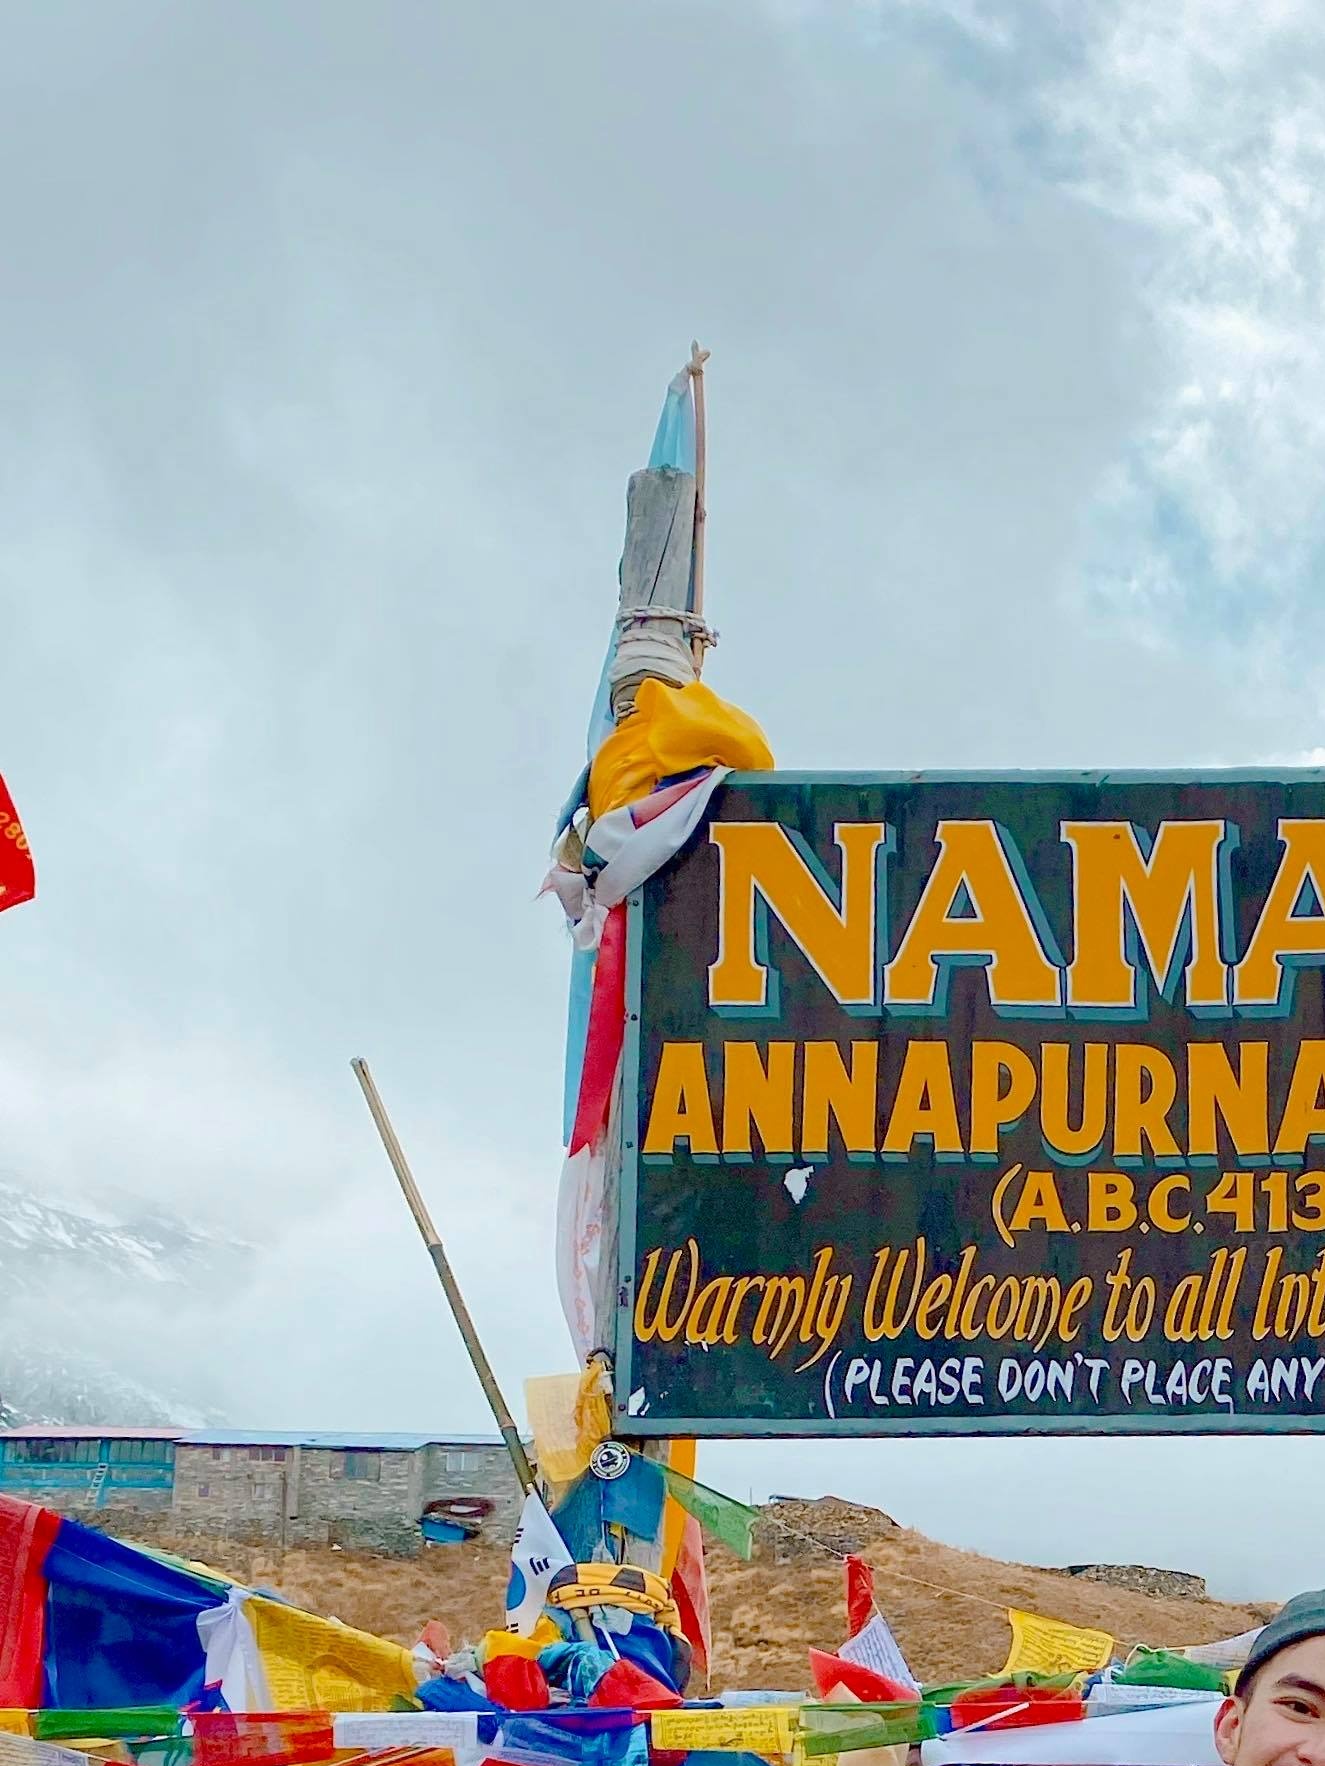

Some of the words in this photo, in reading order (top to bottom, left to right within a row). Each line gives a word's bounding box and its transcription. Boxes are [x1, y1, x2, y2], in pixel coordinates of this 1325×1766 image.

[634, 1237, 852, 1372] Warmly
[864, 1236, 1092, 1352] Welcome
[1103, 1247, 1154, 1343] to
[1162, 1245, 1248, 1341] all
[824, 1350, 985, 1418] (PLEASE
[999, 1352, 1108, 1405] DON'T
[1121, 1355, 1235, 1405] PLACE
[1246, 1356, 1324, 1402] ANY
